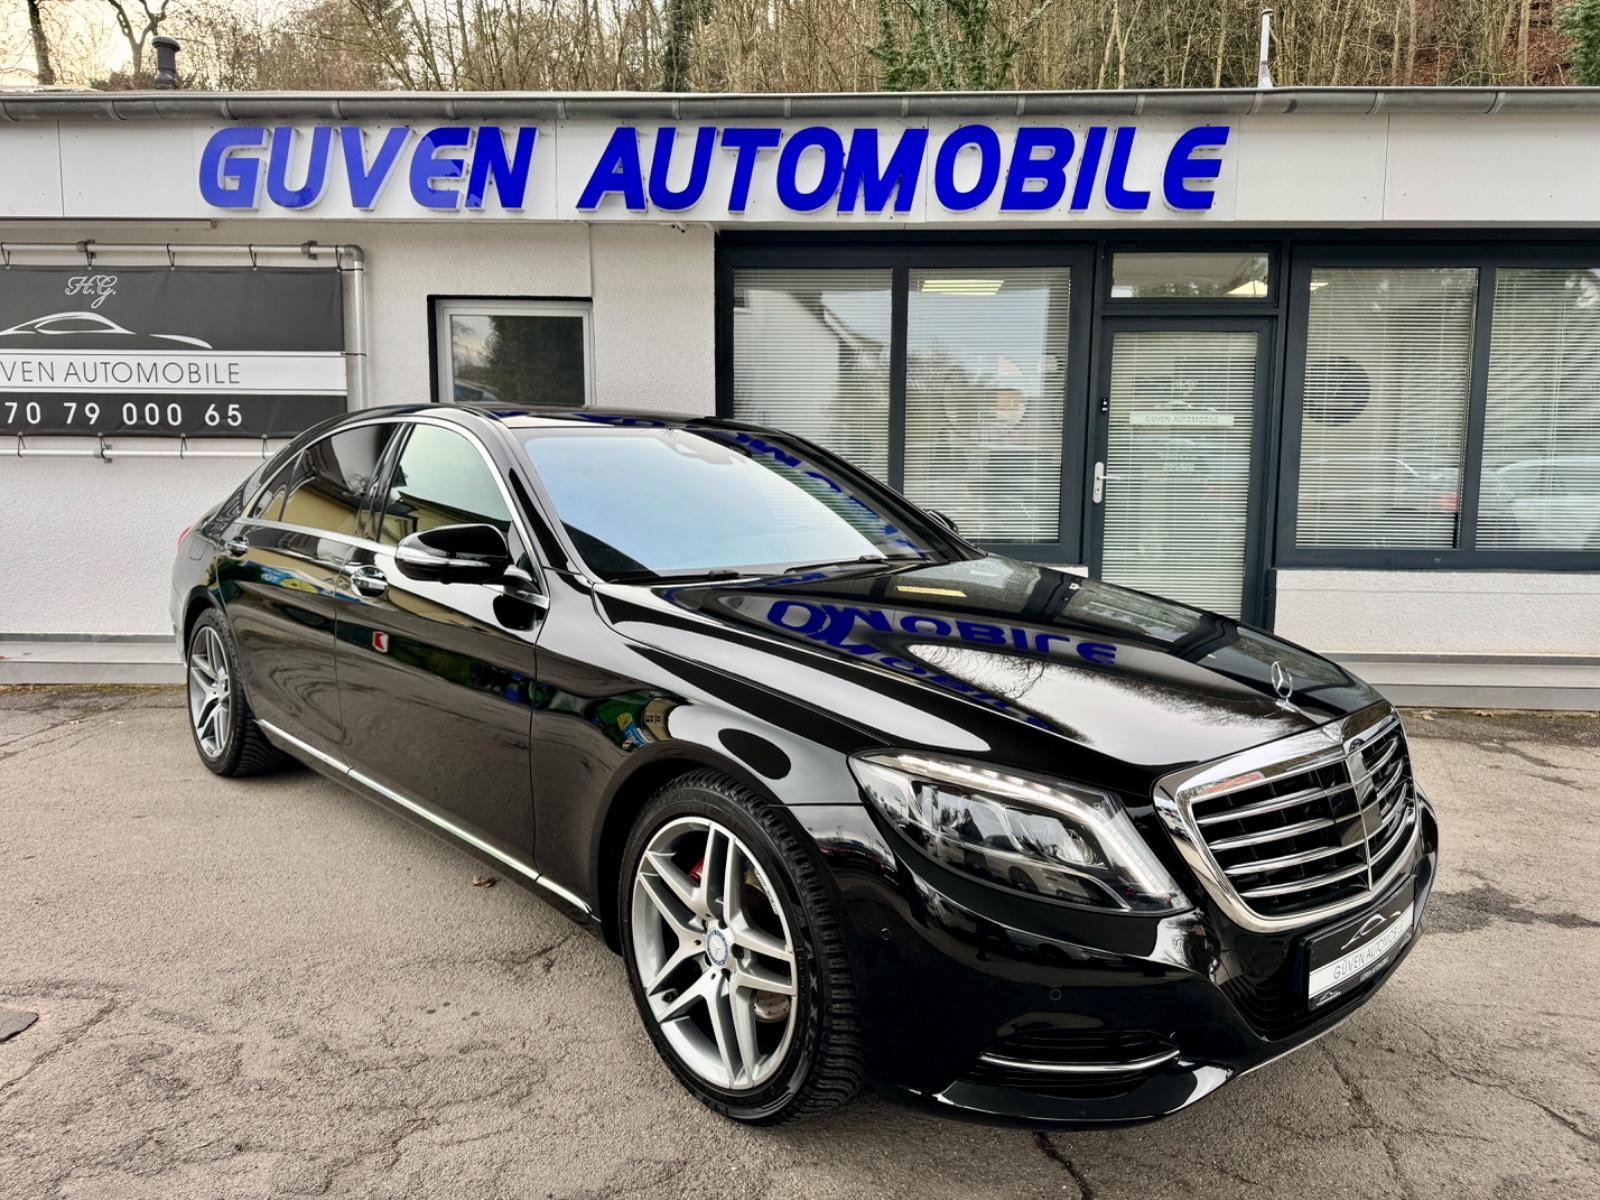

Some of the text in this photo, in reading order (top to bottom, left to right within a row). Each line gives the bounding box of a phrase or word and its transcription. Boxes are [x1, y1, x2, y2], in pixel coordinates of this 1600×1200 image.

[199, 124, 1231, 213] GUVEN AUTOMOBILE
[0, 361, 240, 384] VEN AUTOMOBILE
[4, 402, 242, 427] 70 79 000 65
